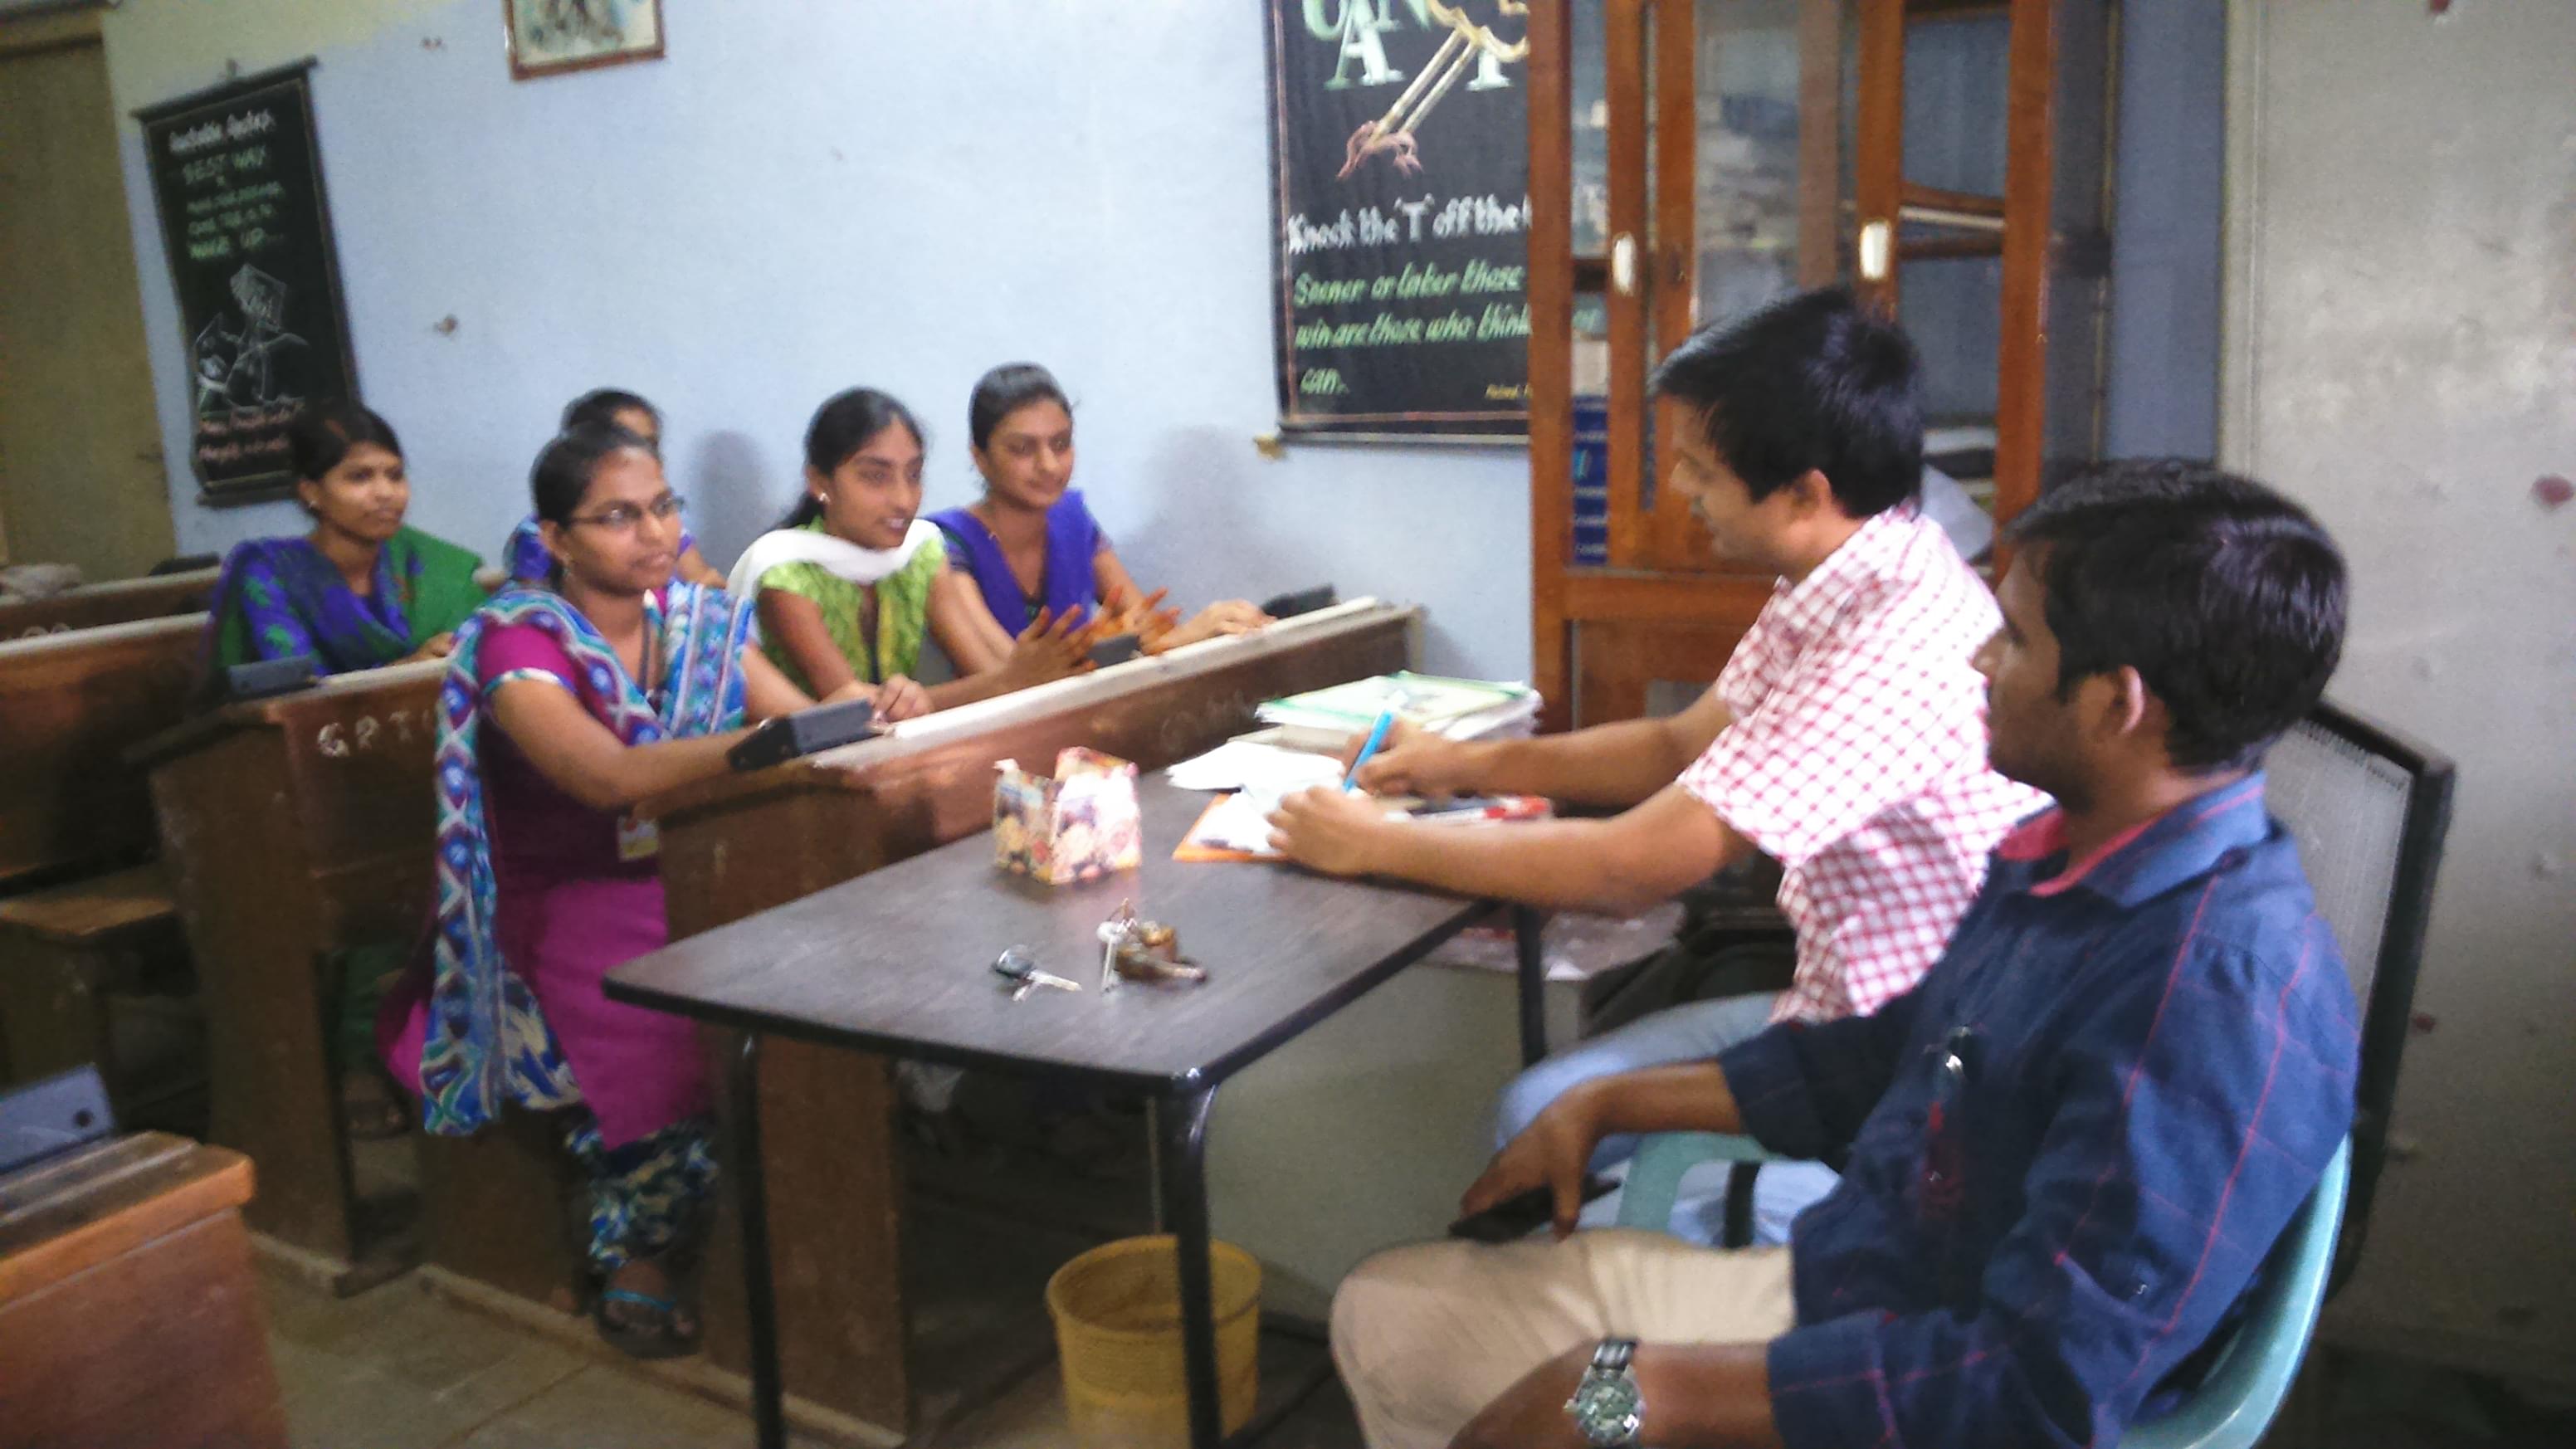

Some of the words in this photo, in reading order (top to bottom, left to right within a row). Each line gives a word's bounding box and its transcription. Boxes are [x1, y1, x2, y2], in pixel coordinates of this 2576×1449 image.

[1288, 208, 1356, 255] Knock
[1359, 206, 1400, 247] the
[1432, 196, 1475, 238] off
[1475, 193, 1521, 236] the
[1293, 272, 1368, 308] Sooner
[1370, 275, 1397, 301] or
[1460, 258, 1526, 295] those
[1295, 318, 1333, 350] win
[1332, 321, 1369, 348] are
[1368, 311, 1423, 346] those
[1425, 309, 1476, 343] who
